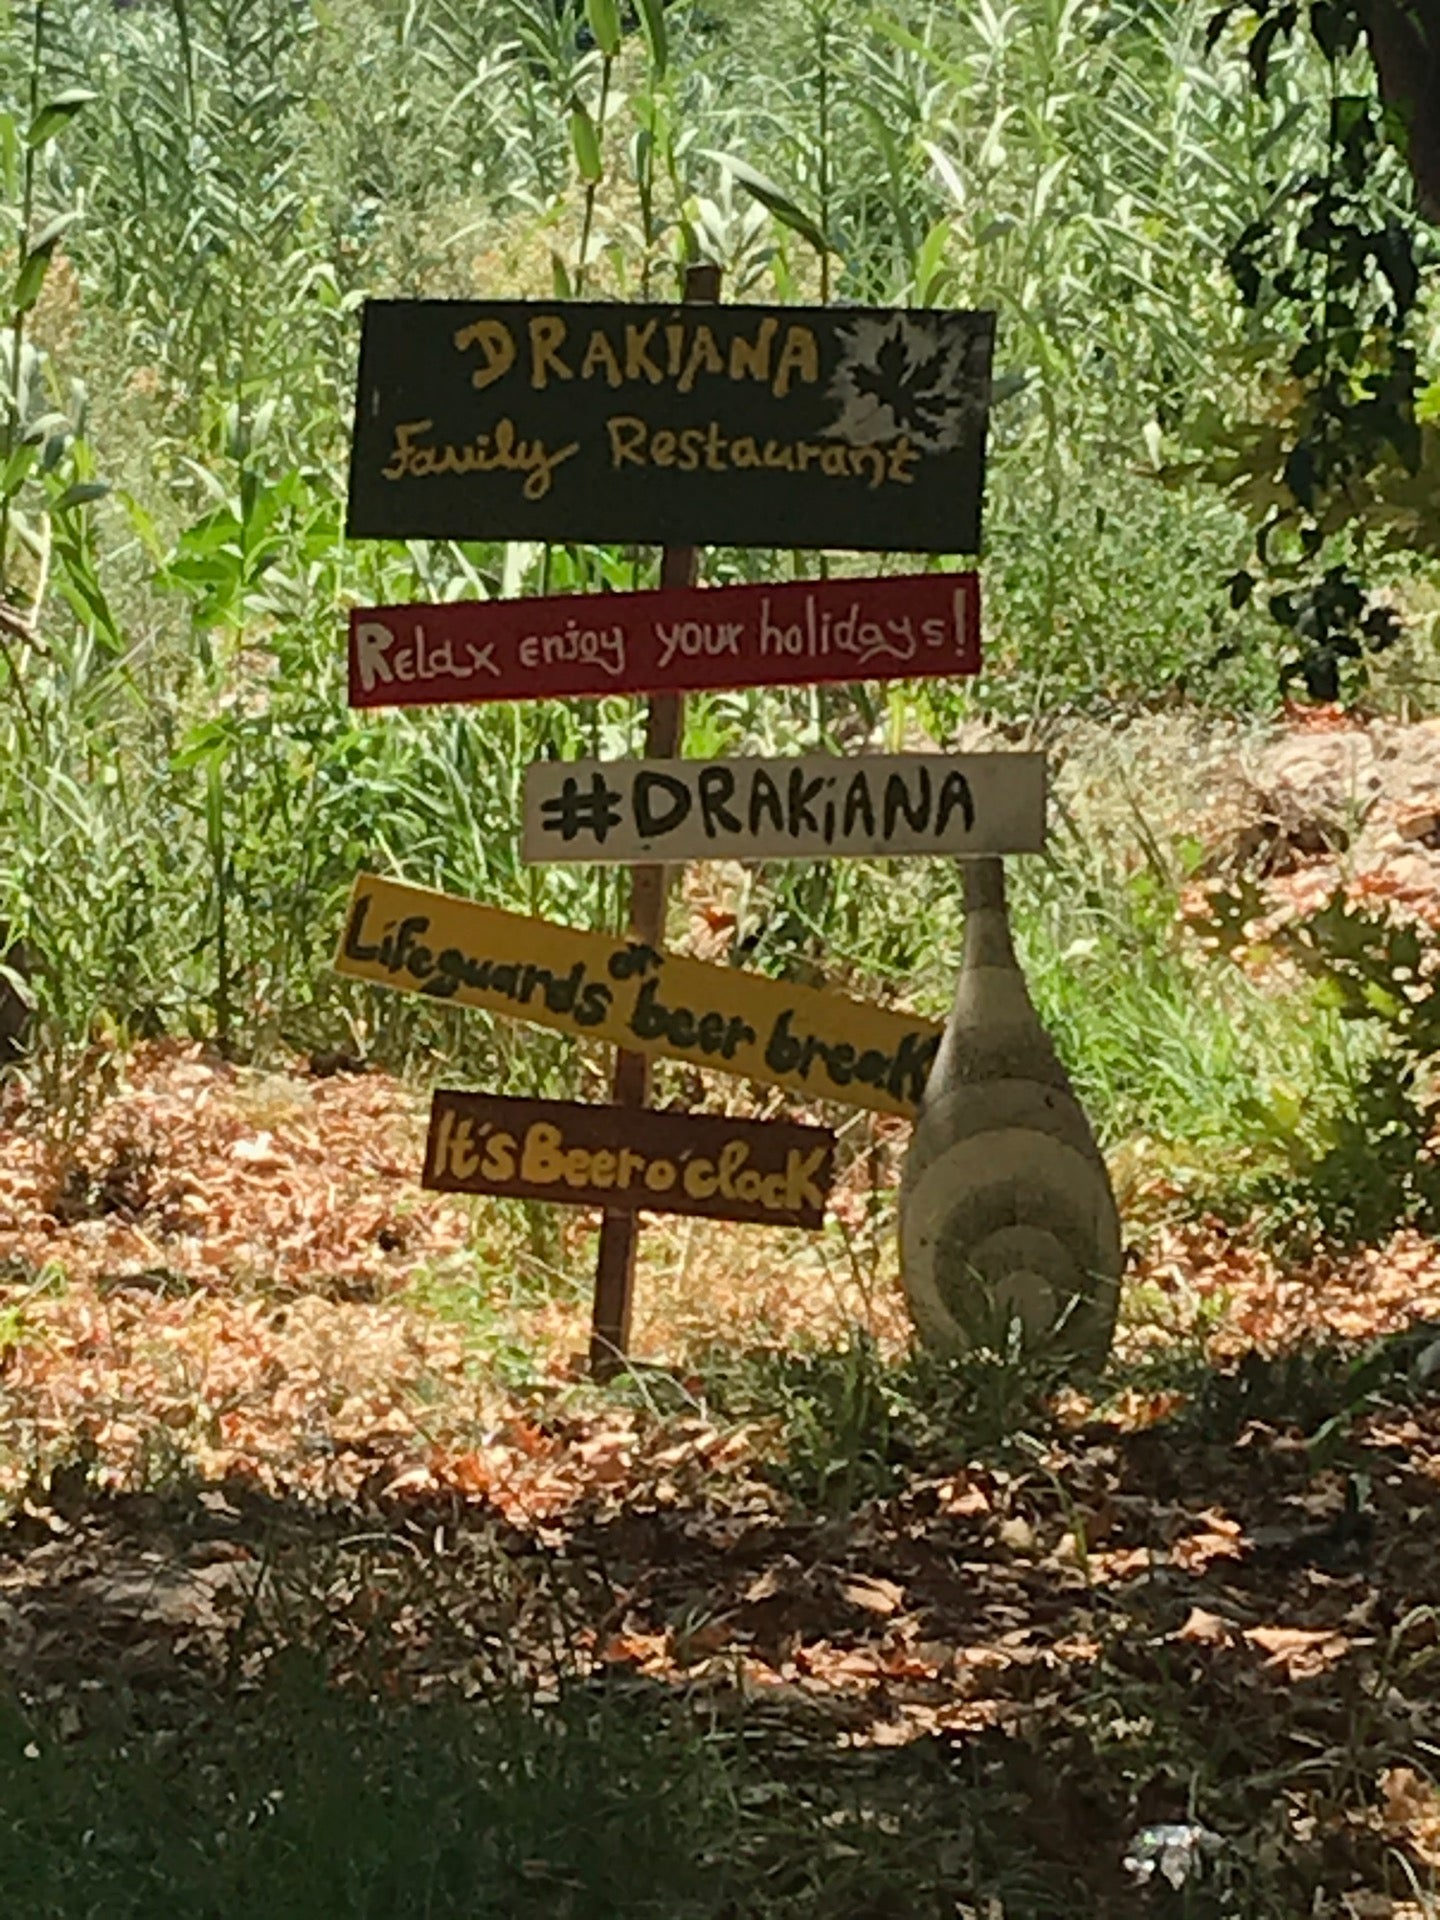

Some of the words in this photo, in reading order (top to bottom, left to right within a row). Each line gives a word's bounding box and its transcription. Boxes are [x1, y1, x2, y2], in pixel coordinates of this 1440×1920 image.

[381, 417, 580, 500] Family
[606, 415, 920, 489] Restaurant
[356, 622, 500, 692] Relax
[518, 619, 626, 676] enjoy
[655, 621, 744, 668] your
[760, 587, 967, 665] holidays!
[345, 894, 613, 1027] Lifeguards
[628, 977, 757, 1060] beer
[520, 1121, 646, 1190] Beer
